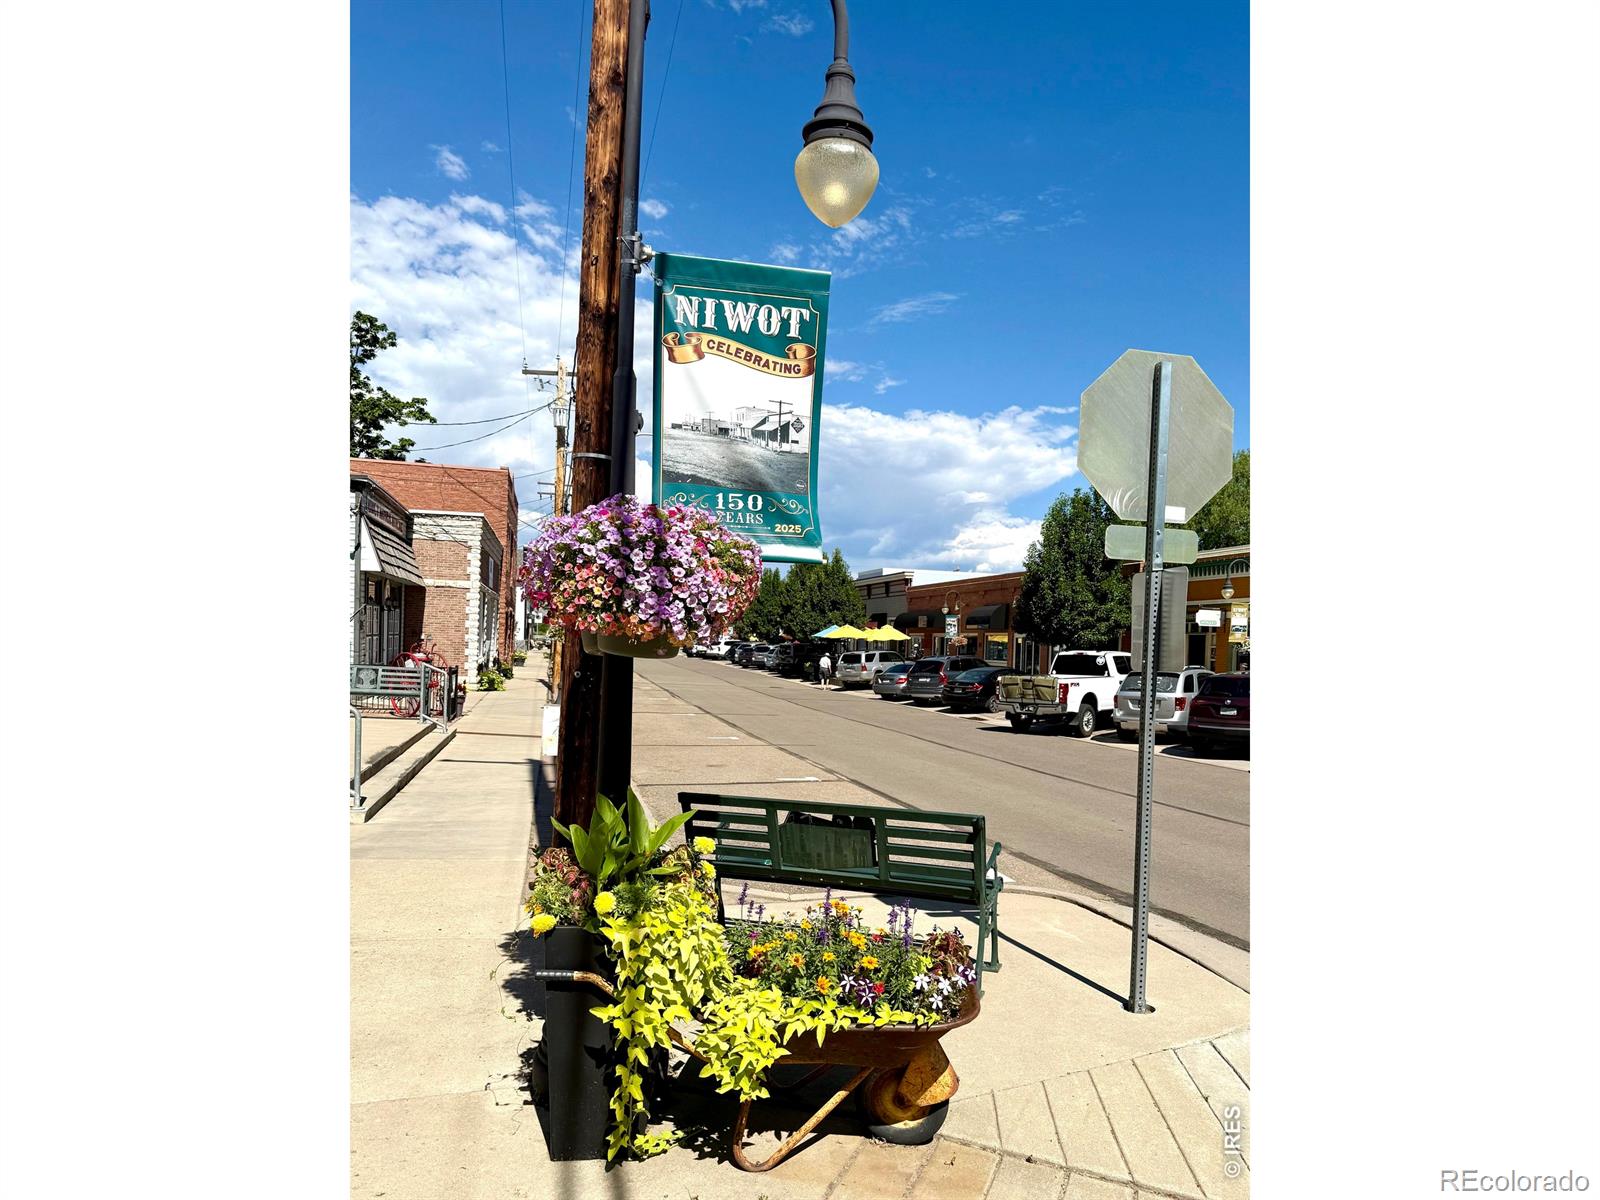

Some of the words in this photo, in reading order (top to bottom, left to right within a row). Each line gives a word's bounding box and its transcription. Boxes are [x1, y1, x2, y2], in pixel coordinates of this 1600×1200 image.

[674, 294, 810, 339] NIWOT
[706, 339, 801, 375] CELEBRATING
[715, 492, 763, 512] 150
[774, 523, 801, 533] 2025
